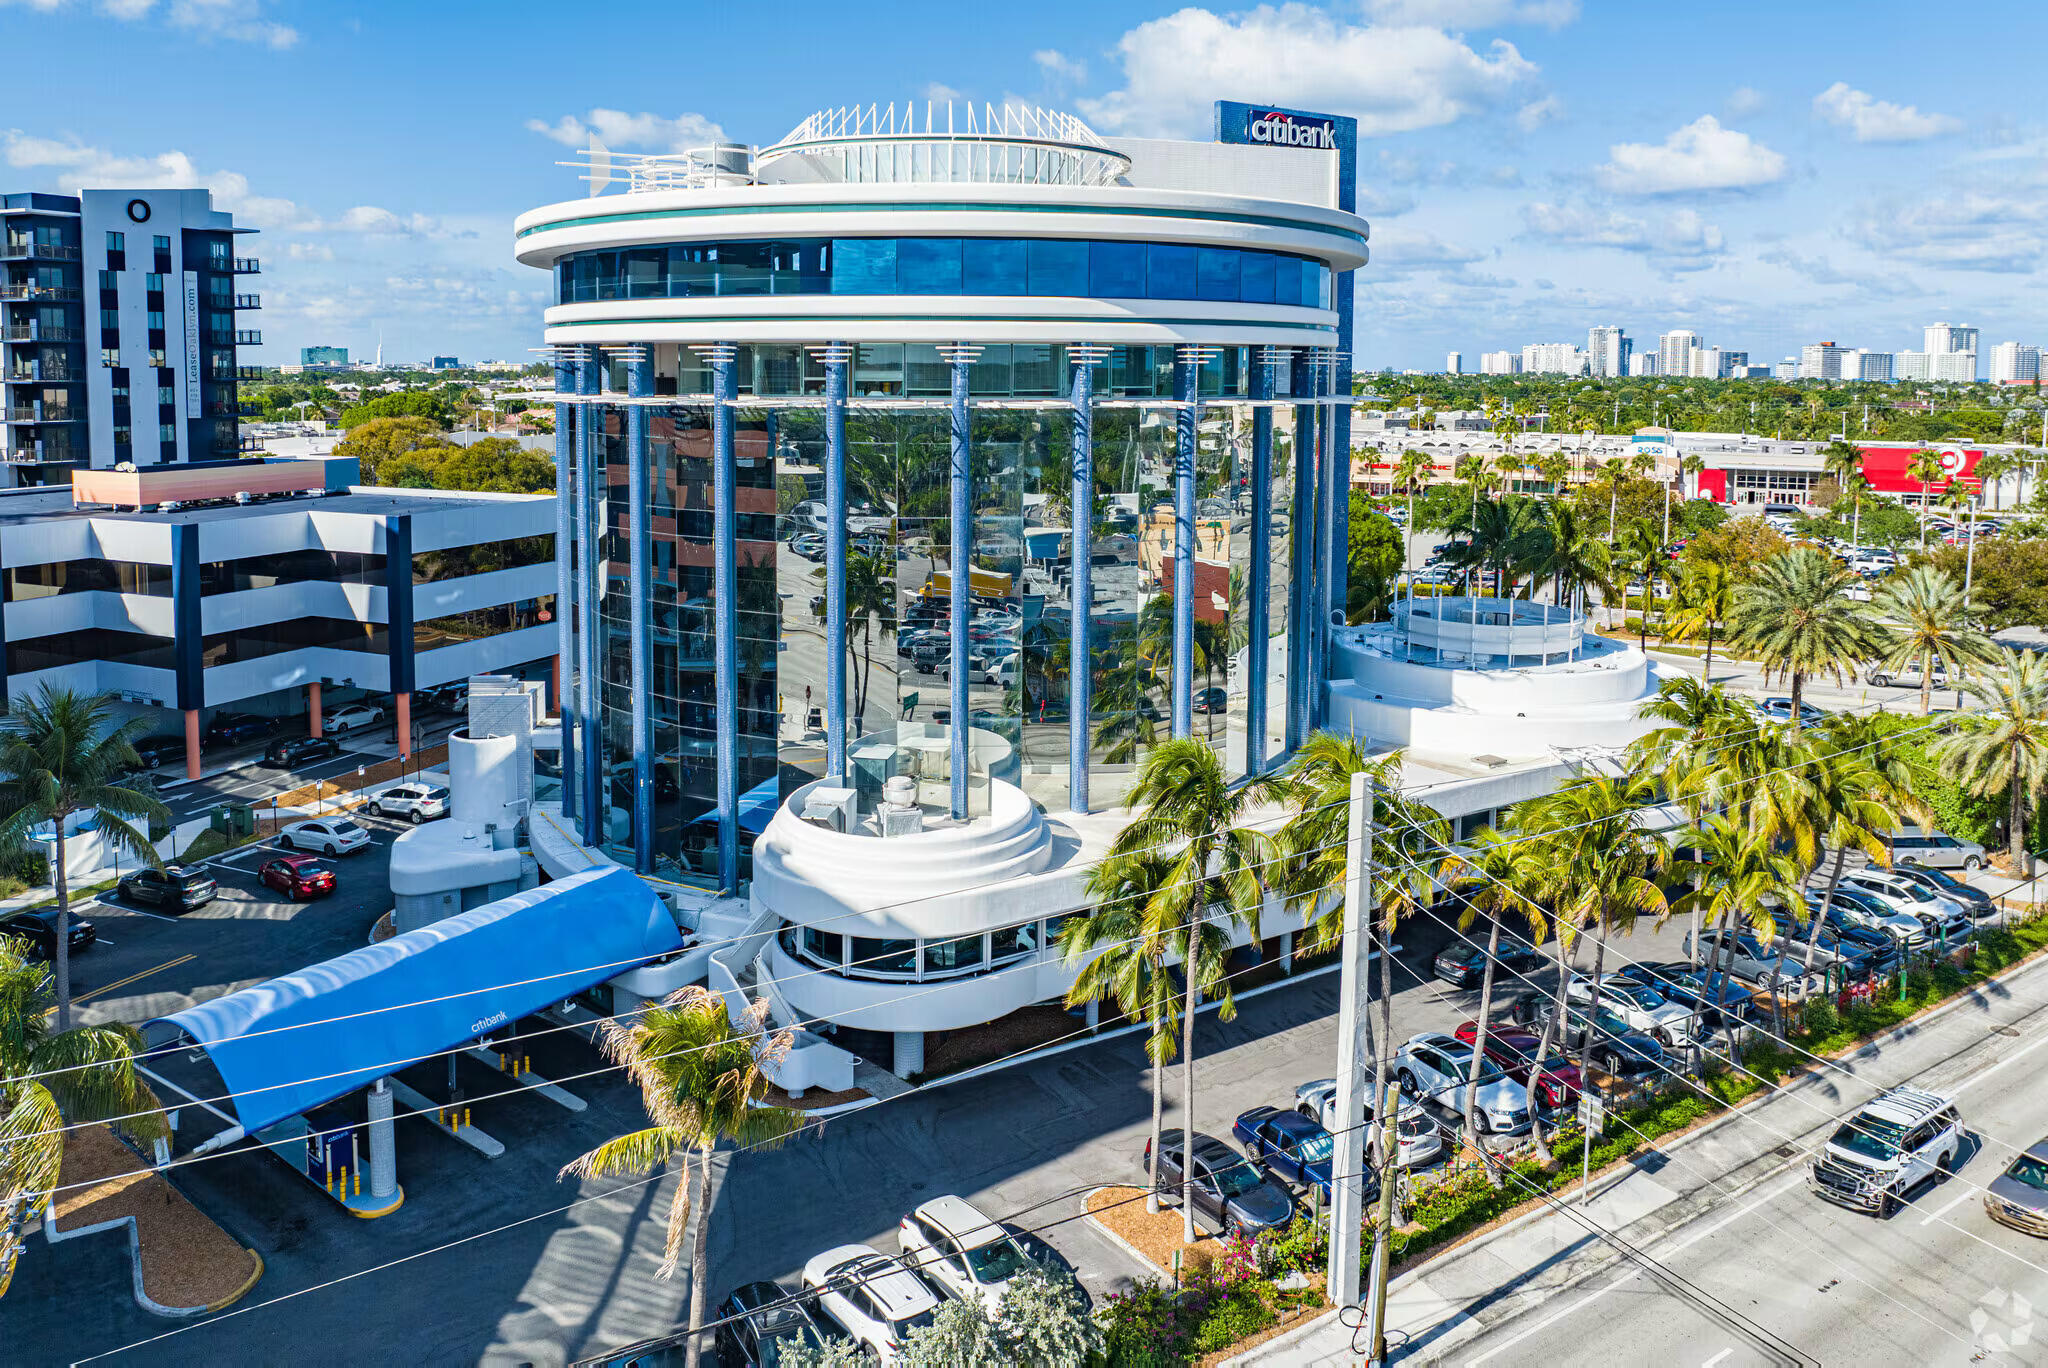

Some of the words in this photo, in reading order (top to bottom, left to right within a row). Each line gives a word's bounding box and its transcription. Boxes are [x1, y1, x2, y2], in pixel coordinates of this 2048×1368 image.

[1251, 114, 1337, 149] citibank
[128, 199, 151, 223] O
[1637, 446, 1663, 454] ROSS
[471, 1010, 508, 1033] citibank
